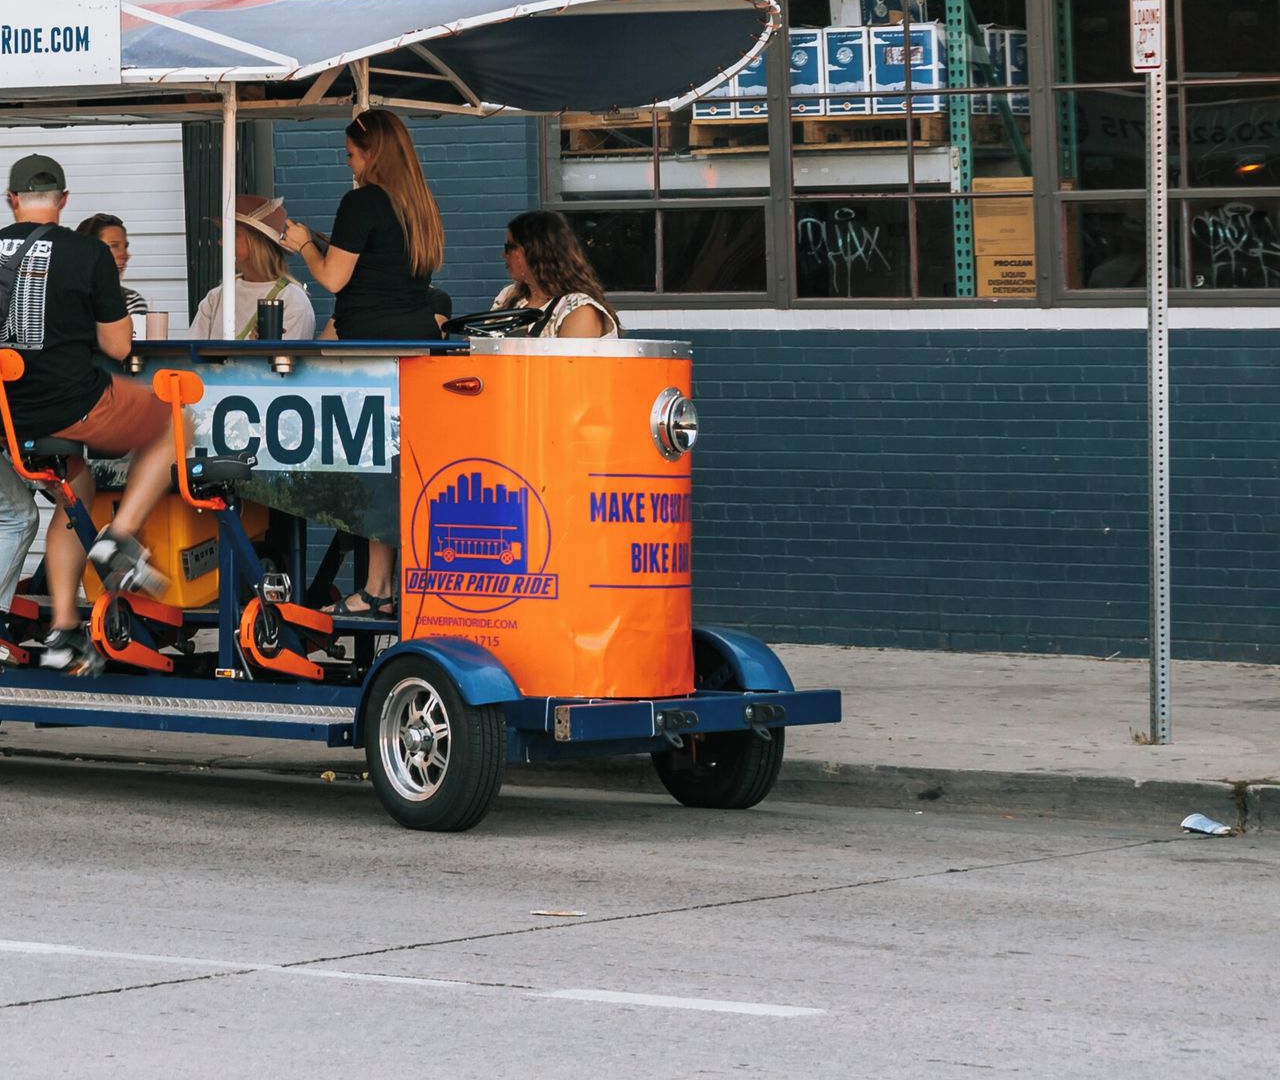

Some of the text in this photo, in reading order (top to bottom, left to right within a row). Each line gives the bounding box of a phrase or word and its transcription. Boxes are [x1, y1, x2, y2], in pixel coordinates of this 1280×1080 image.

[1134, 8, 1160, 25] LOADING
[590, 492, 645, 523] MAKE
[631, 542, 669, 574] BIKE
[408, 572, 553, 595] DENVER PATIO RIDE
[416, 616, 518, 629] DENVERPATIORIDE.COM
